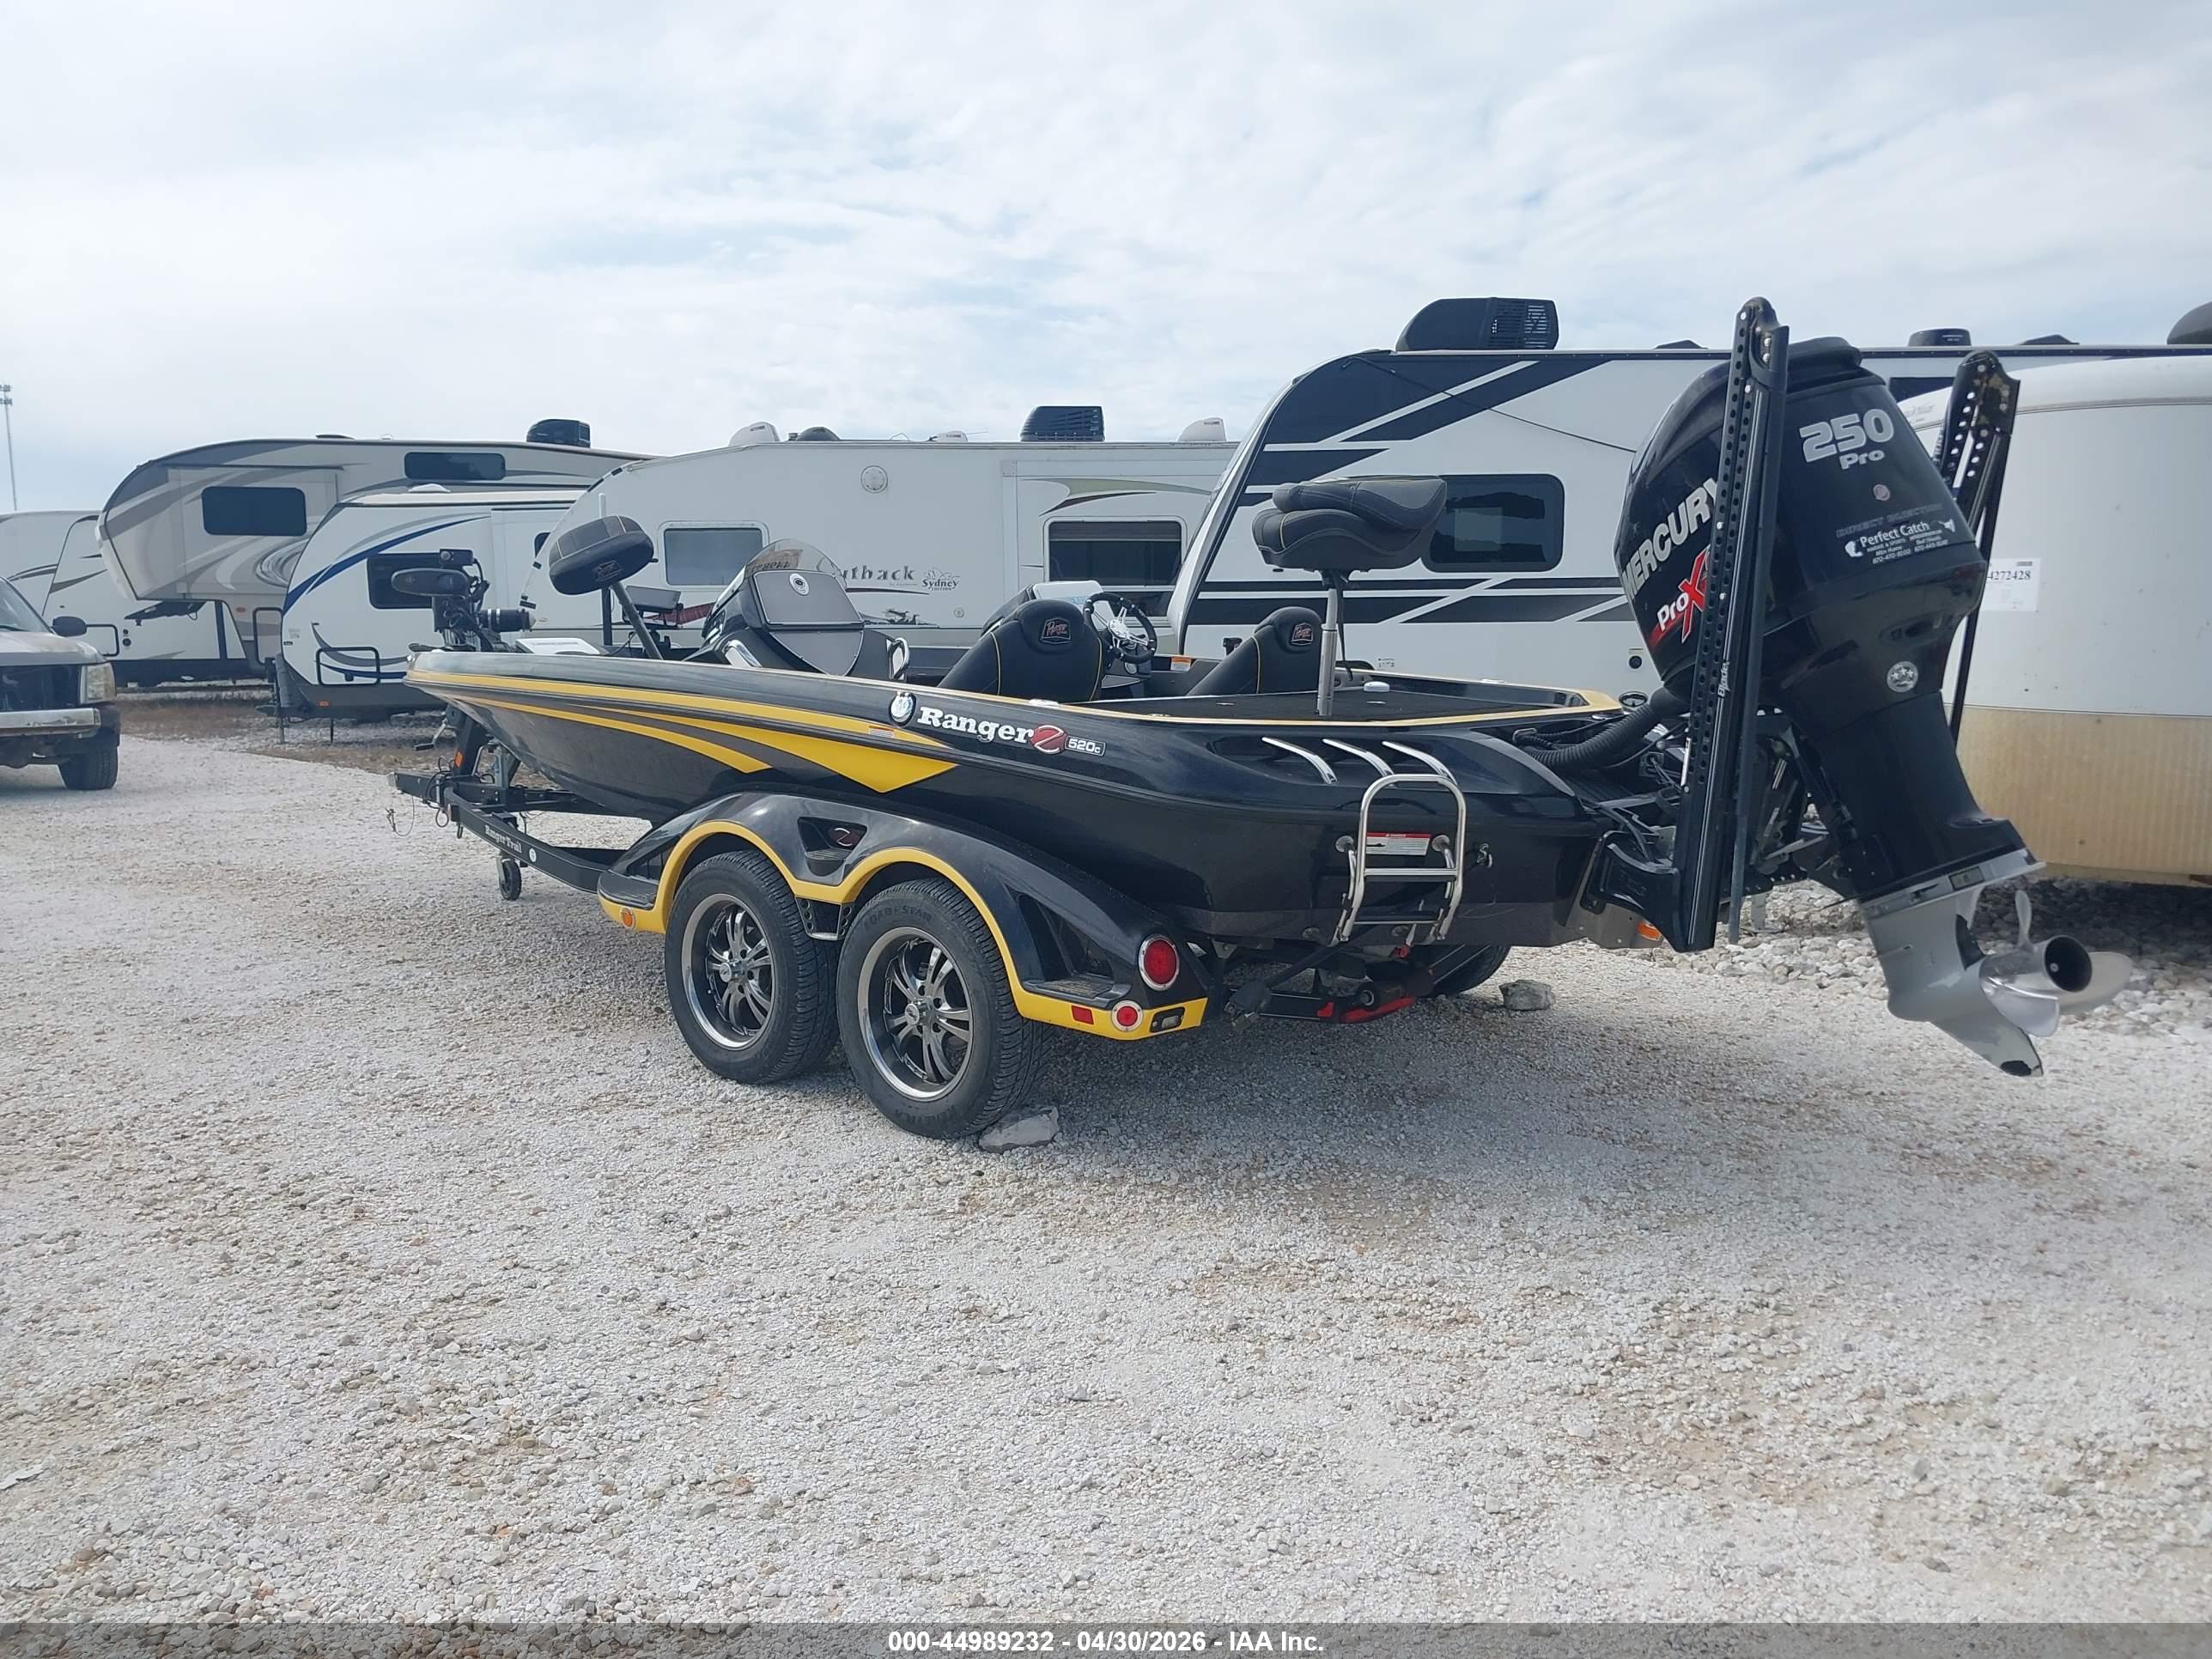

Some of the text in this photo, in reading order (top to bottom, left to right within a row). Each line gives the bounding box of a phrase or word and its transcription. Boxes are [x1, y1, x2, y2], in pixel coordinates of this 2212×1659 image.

[1799, 409, 1894, 463] 250
[1839, 450, 1885, 470] Pro
[1860, 527, 1899, 547] Perfect
[1899, 520, 1930, 537] Catch
[922, 577, 958, 590] Sydney
[917, 706, 1034, 744] Ranger
